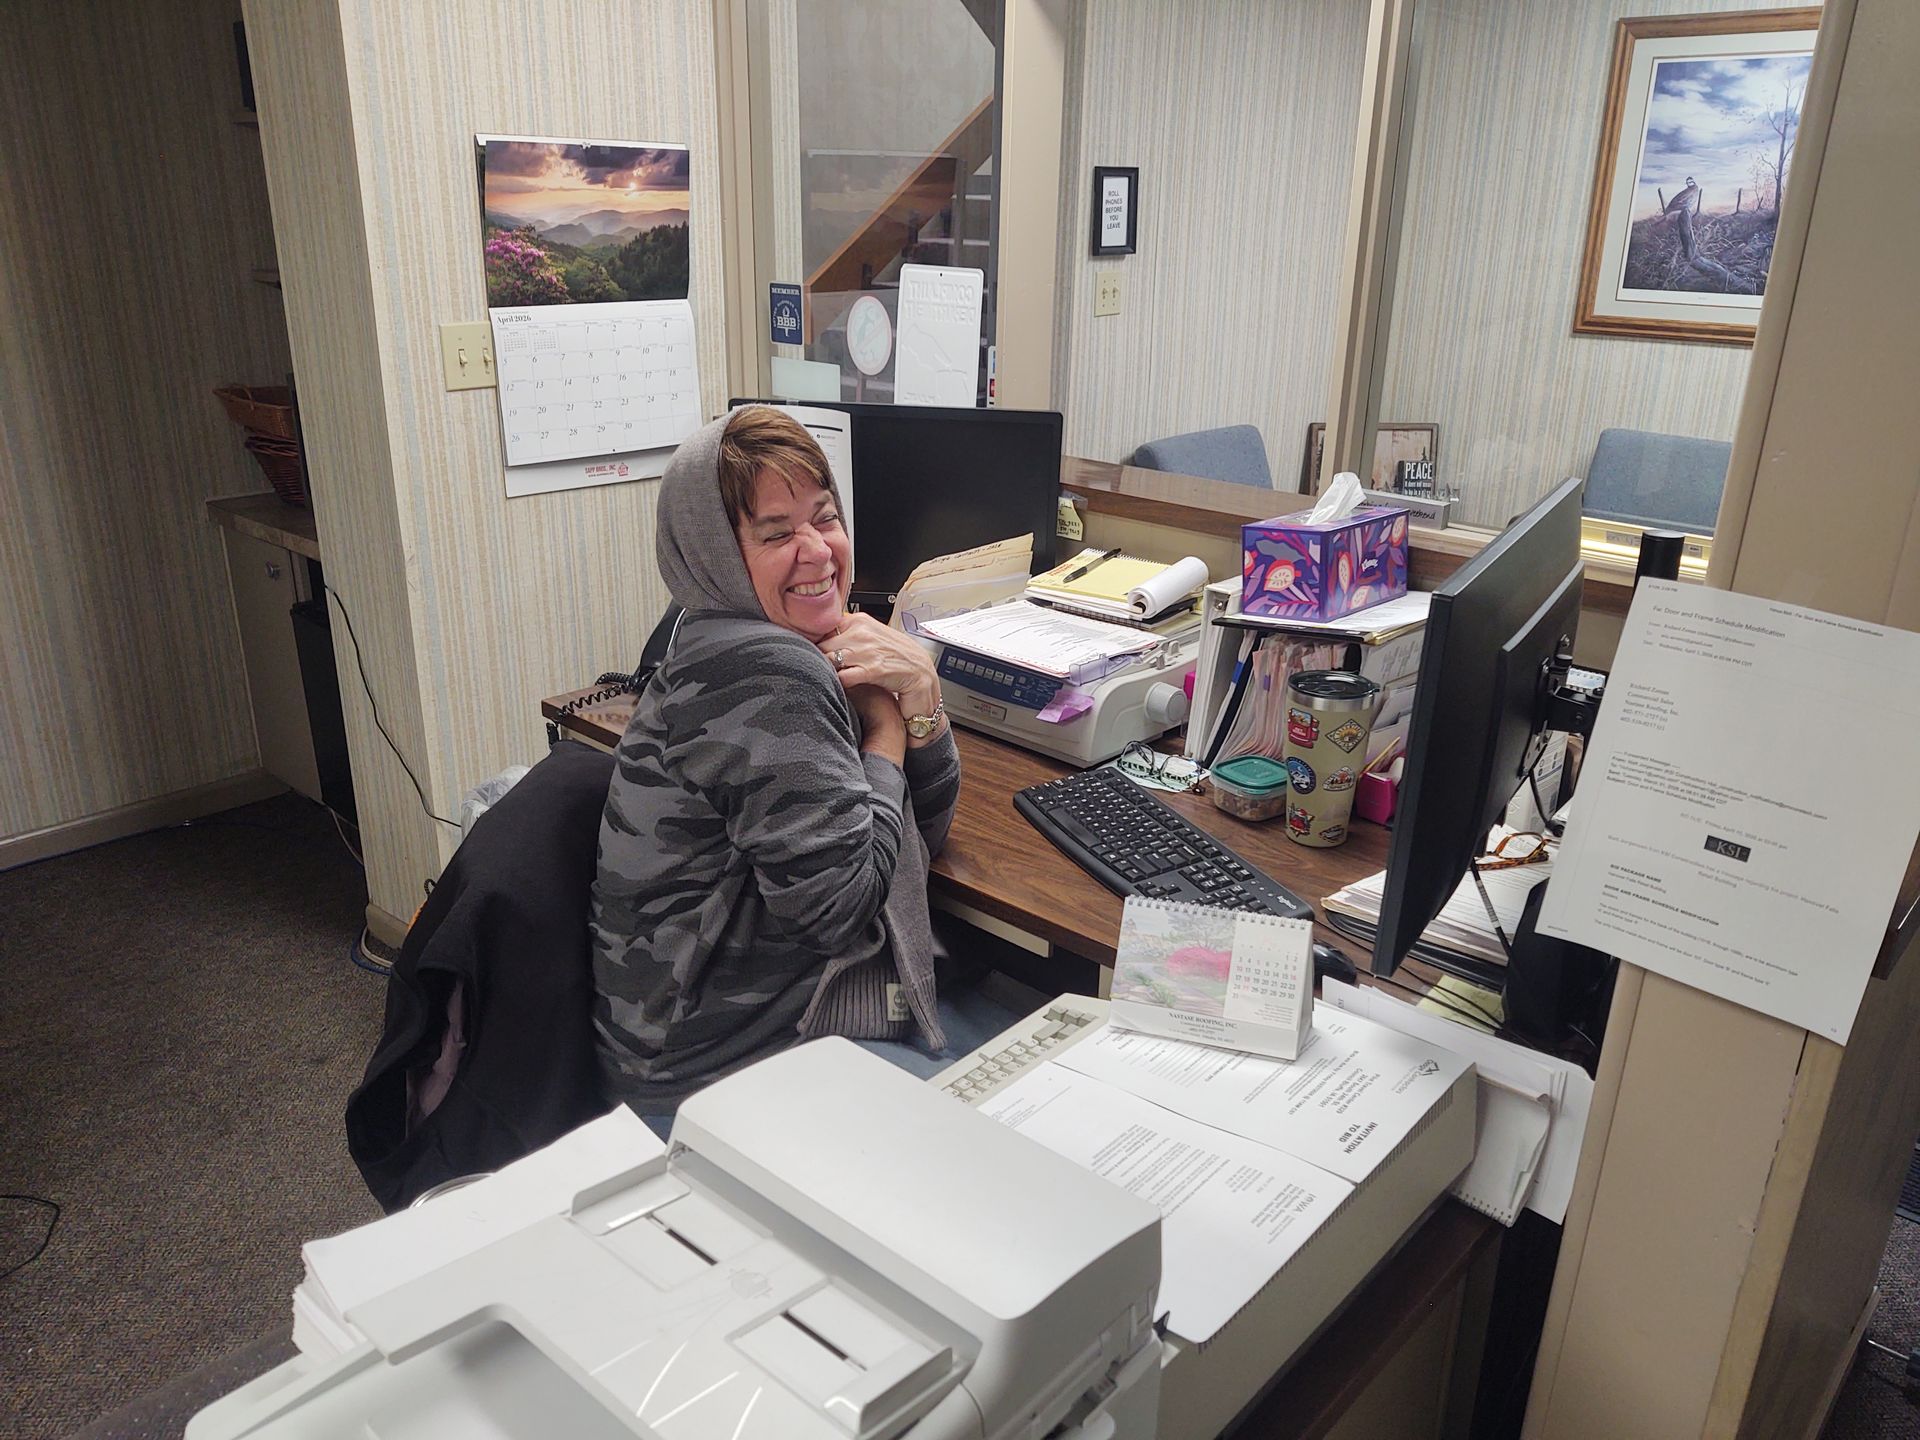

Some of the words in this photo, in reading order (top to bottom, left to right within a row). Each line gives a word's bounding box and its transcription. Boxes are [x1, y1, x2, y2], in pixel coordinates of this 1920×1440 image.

[771, 287, 800, 296] MEMBER
[497, 315, 513, 325] April
[777, 316, 796, 327] BBB
[642, 347, 650, 355] 10
[536, 381, 544, 389] 13
[645, 371, 652, 379] 17
[566, 403, 574, 411] 21
[621, 398, 628, 406] 23
[647, 395, 655, 403] 24
[512, 434, 520, 442] 26
[541, 431, 549, 439] 27
[624, 422, 632, 430] 30
[1405, 462, 1432, 479] PEACE
[1663, 606, 1680, 615] Door
[1680, 609, 1693, 618] and
[1693, 611, 1714, 622] Frame
[1713, 616, 1744, 629] Schedule
[1744, 622, 1786, 639] Modification
[1716, 839, 1742, 859] KSI
[1169, 1012, 1194, 1021] NASTASE
[1196, 1017, 1224, 1027] ROOFING,
[1345, 1067, 1363, 1081] Council
[1343, 1081, 1360, 1094] South
[1356, 1081, 1373, 1094] Travel
[1396, 1071, 1423, 1094] Contractors
[1343, 1091, 1362, 1105] Center
[1348, 1123, 1360, 1132] TO
[1338, 1131, 1352, 1143] BID
[1343, 1122, 1378, 1154] INVITATION
[1296, 1193, 1317, 1212] IOWA
